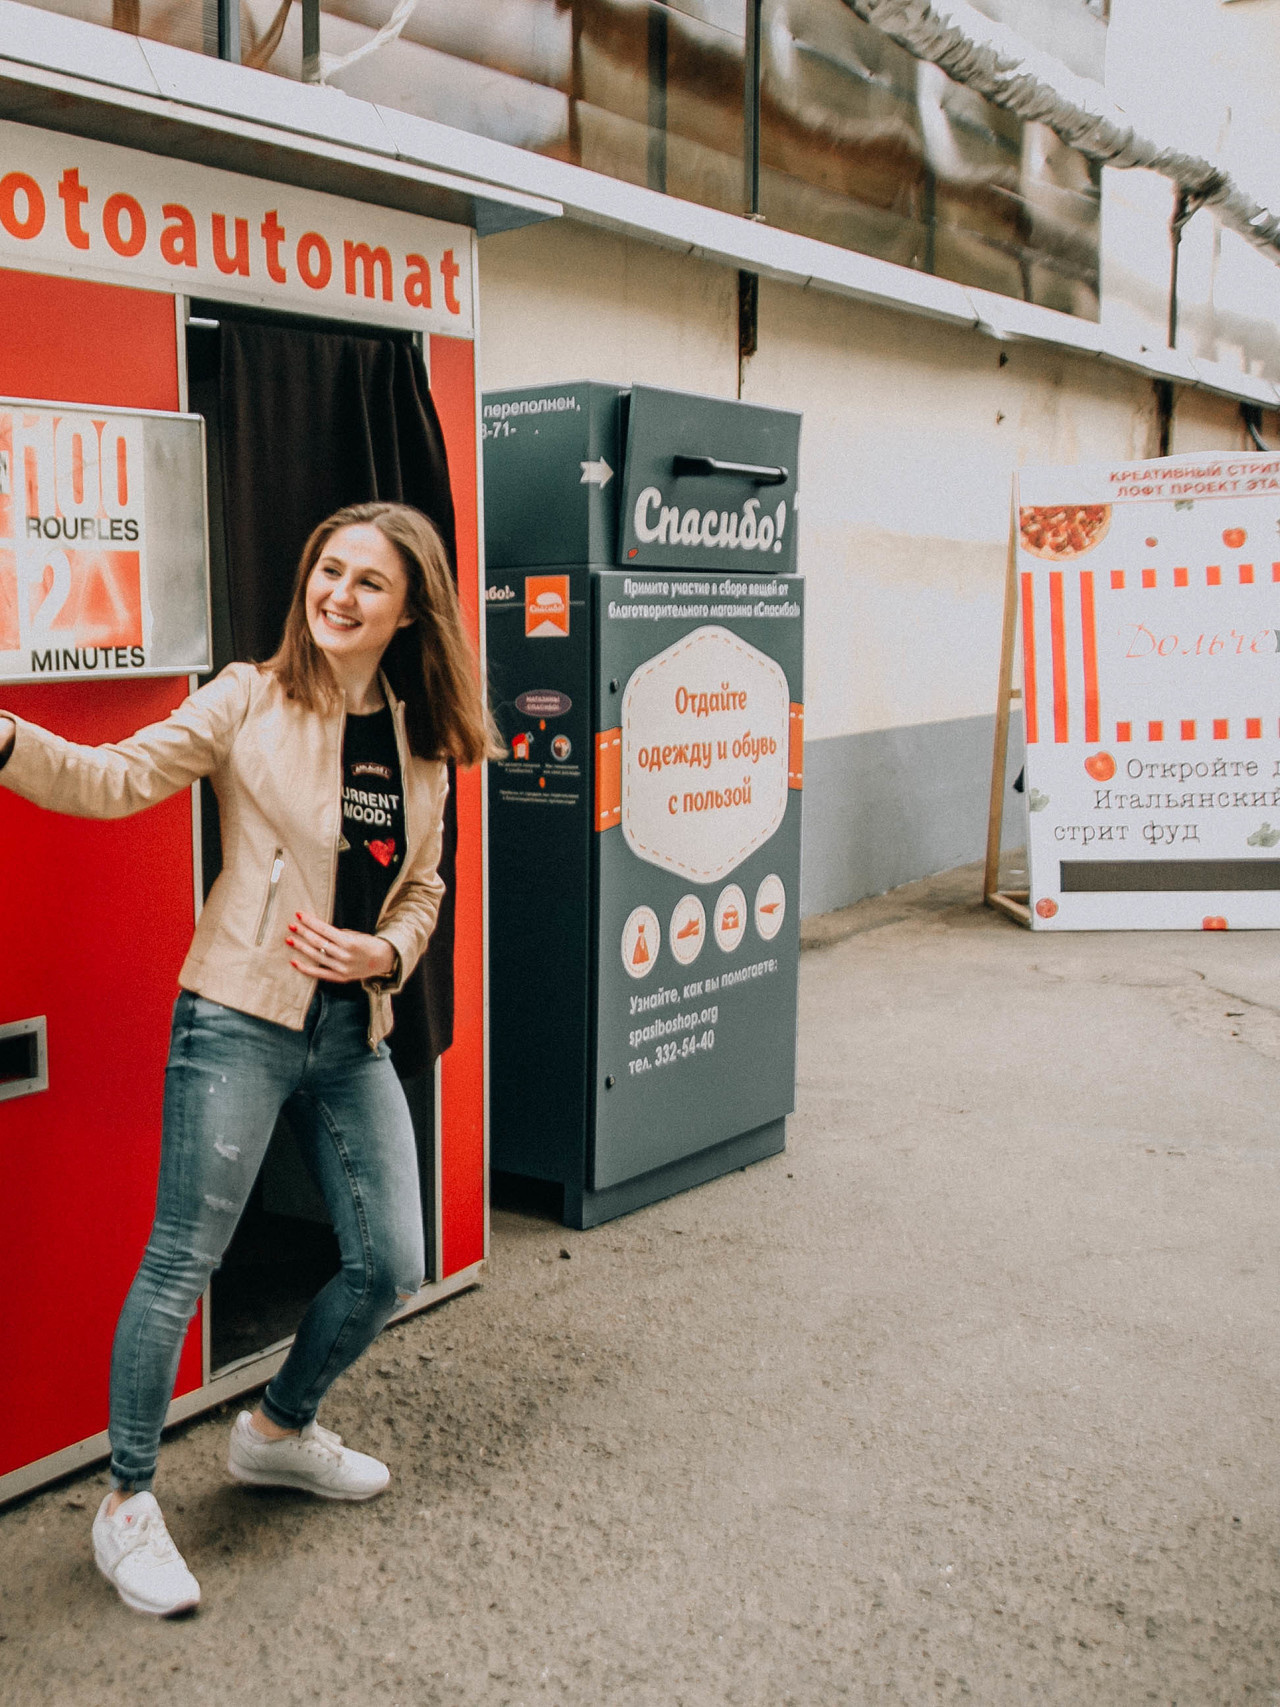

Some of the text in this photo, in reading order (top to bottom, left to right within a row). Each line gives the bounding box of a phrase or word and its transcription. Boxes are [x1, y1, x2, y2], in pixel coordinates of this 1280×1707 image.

[1109, 461, 1280, 482] КРЕАТИВНЫЙ СТРИТ
[1117, 484, 1164, 498] ЛОФТ
[1170, 480, 1240, 495] ПРОЕКТ
[26, 515, 139, 541] ROUBLES
[634, 486, 787, 554] Спасибо!
[624, 577, 789, 599] Примите участие в сборе вещей от
[608, 601, 709, 622] благотворительного
[710, 604, 753, 618] магазина
[1118, 620, 1271, 659] Дольче
[30, 645, 146, 673] MINUTES
[675, 681, 748, 718] Отдайте
[638, 730, 778, 773] одежду и обувь
[1127, 757, 1259, 783] Откройте
[342, 786, 400, 810] URRENT
[668, 776, 752, 815] с пользой
[343, 800, 392, 826] MOOD:
[1054, 820, 1201, 846] стрит фуд
[629, 957, 779, 1015] Узнайте, как вы помогаете:
[628, 1005, 719, 1048] spasiboshop.org
[628, 1029, 716, 1075] тел. 332-54-40
